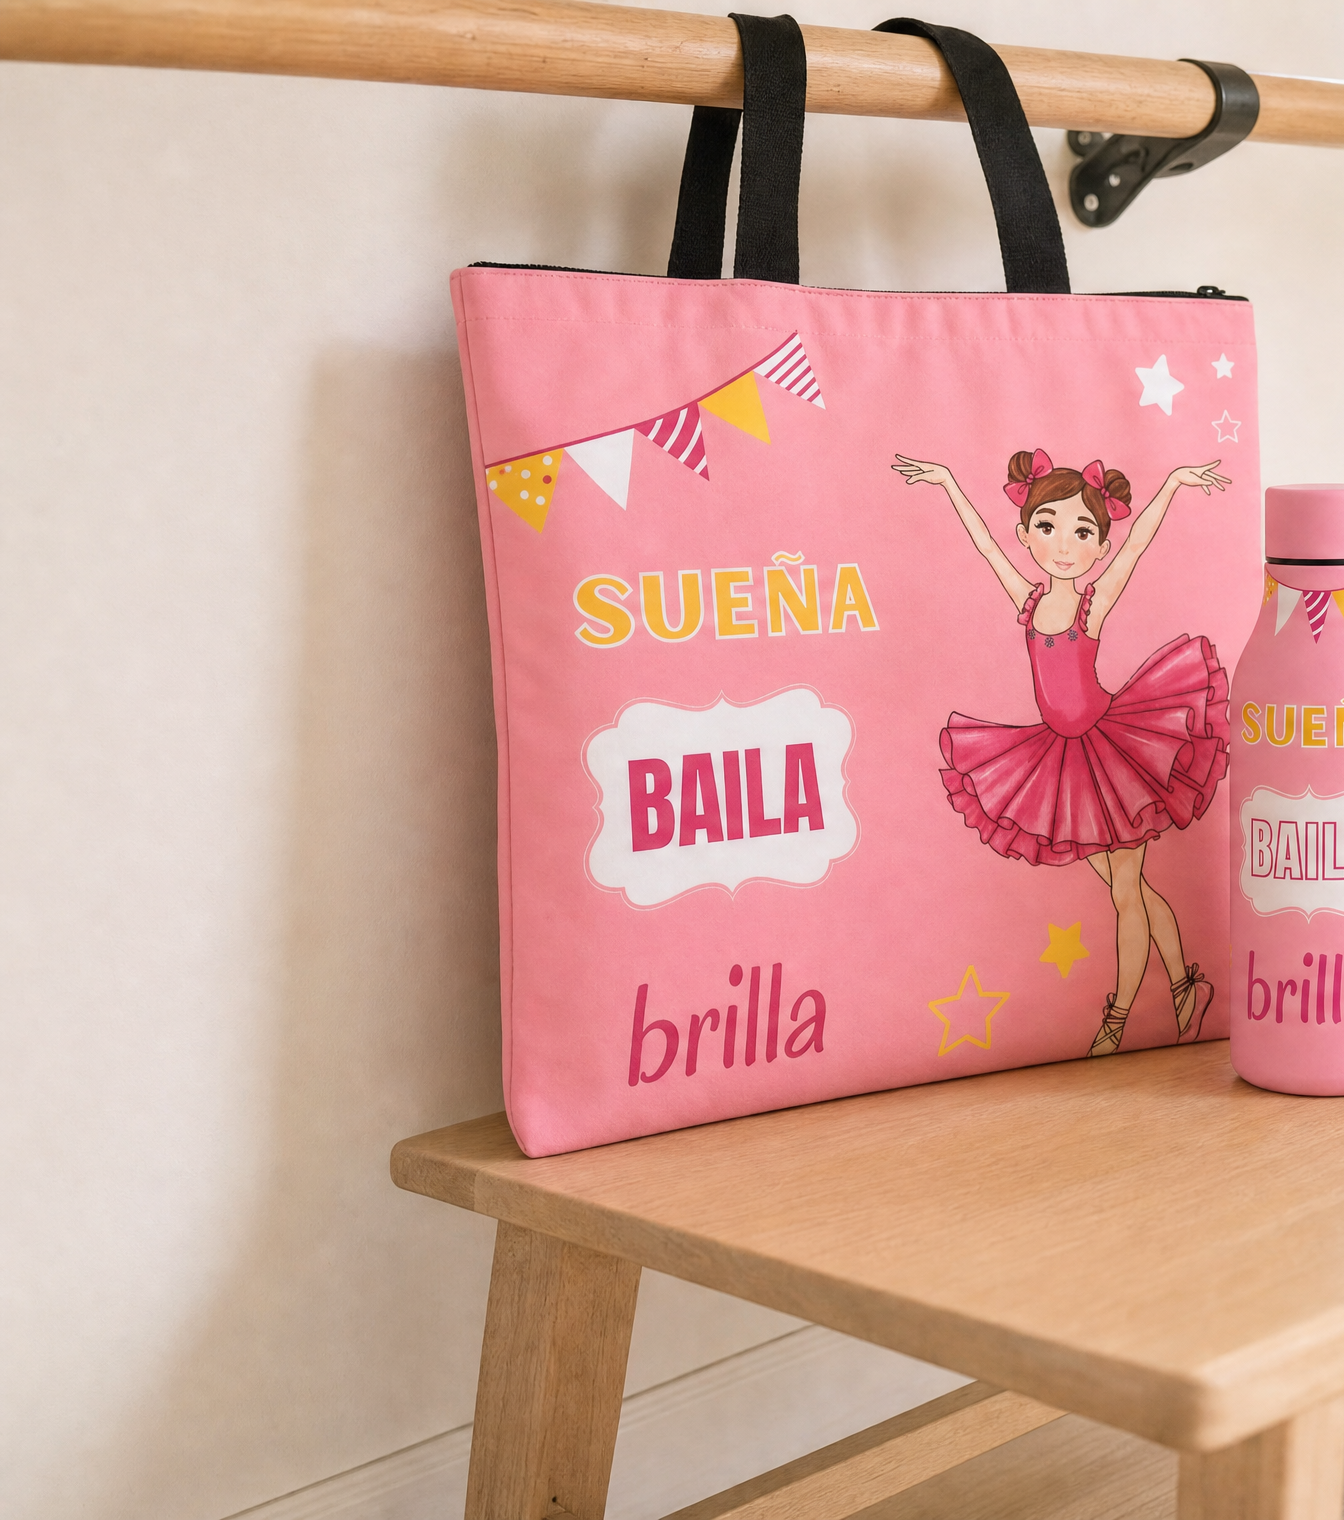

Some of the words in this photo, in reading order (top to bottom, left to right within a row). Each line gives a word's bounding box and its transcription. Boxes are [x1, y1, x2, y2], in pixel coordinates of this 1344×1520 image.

[573, 551, 880, 648] SUEÑA
[628, 743, 825, 852] BAILA
[627, 962, 827, 1087] brilla
